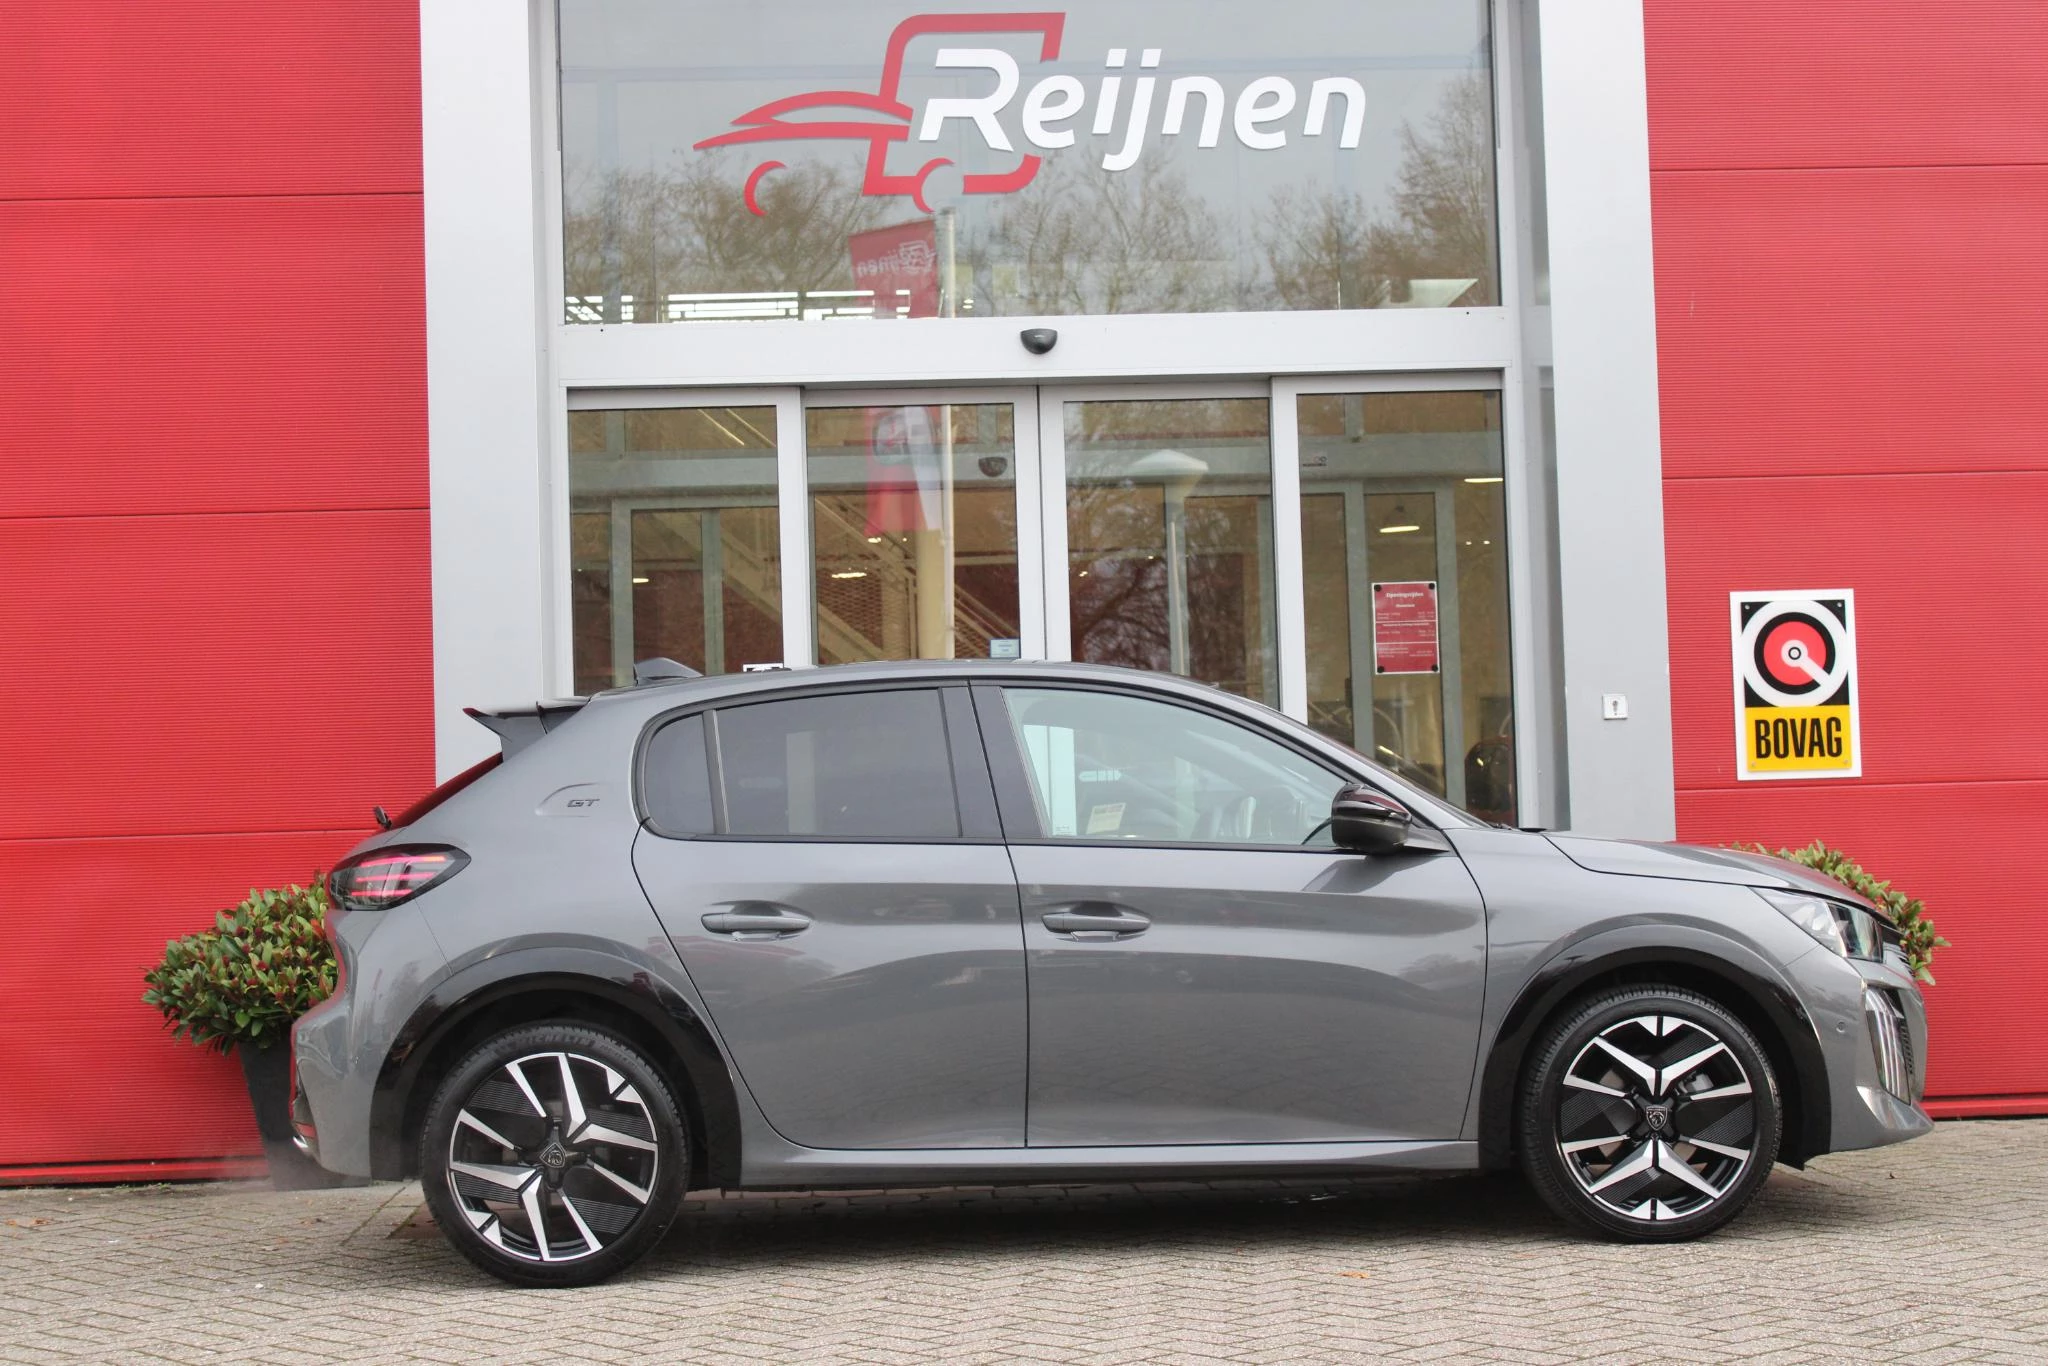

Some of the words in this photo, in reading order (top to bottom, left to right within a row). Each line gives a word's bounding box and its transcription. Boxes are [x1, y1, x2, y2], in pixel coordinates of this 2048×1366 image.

[918, 48, 1367, 172] Reijnen
[1754, 717, 1843, 759] BOVAG
[567, 798, 601, 808] GT
